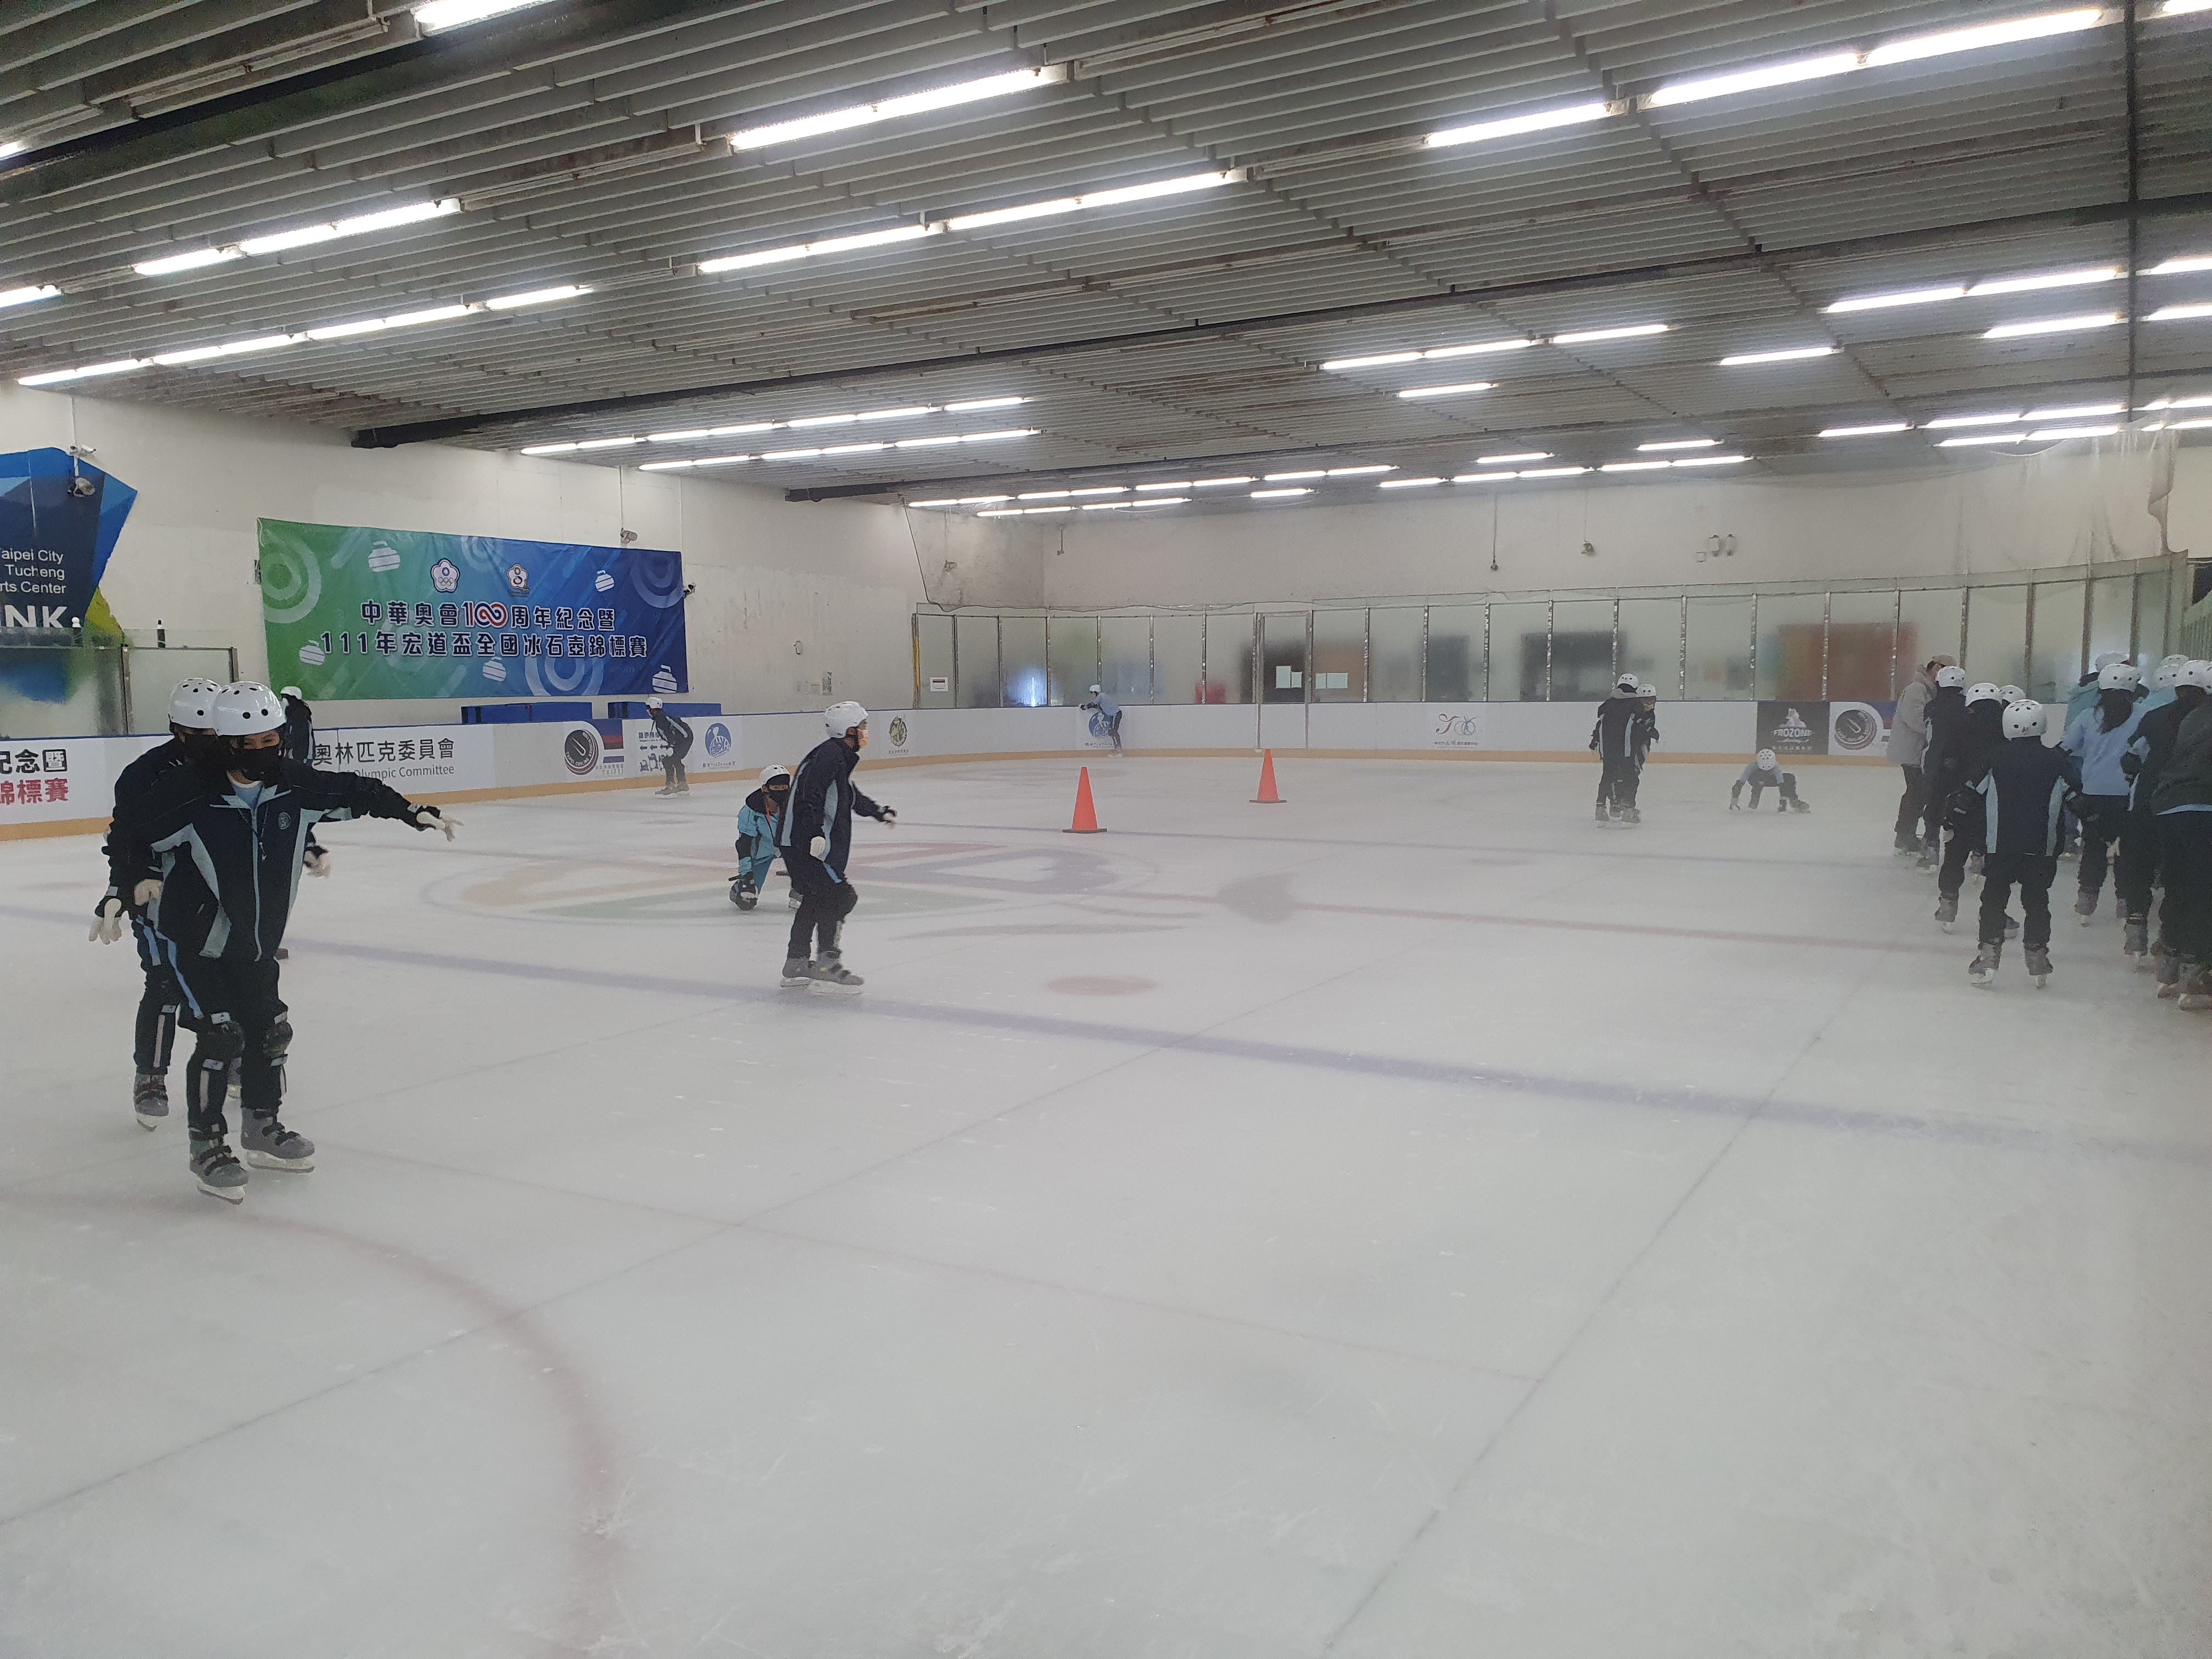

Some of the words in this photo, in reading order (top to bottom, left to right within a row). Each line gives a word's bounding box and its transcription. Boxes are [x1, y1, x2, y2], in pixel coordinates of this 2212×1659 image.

[0, 548, 34, 562] aipei
[38, 549, 64, 565] City
[4, 564, 65, 581] Tucheng
[20, 581, 67, 594] Center
[0, 605, 67, 629] NK
[313, 737, 455, 766] 奧林匹克委員會
[399, 765, 455, 777] Committee
